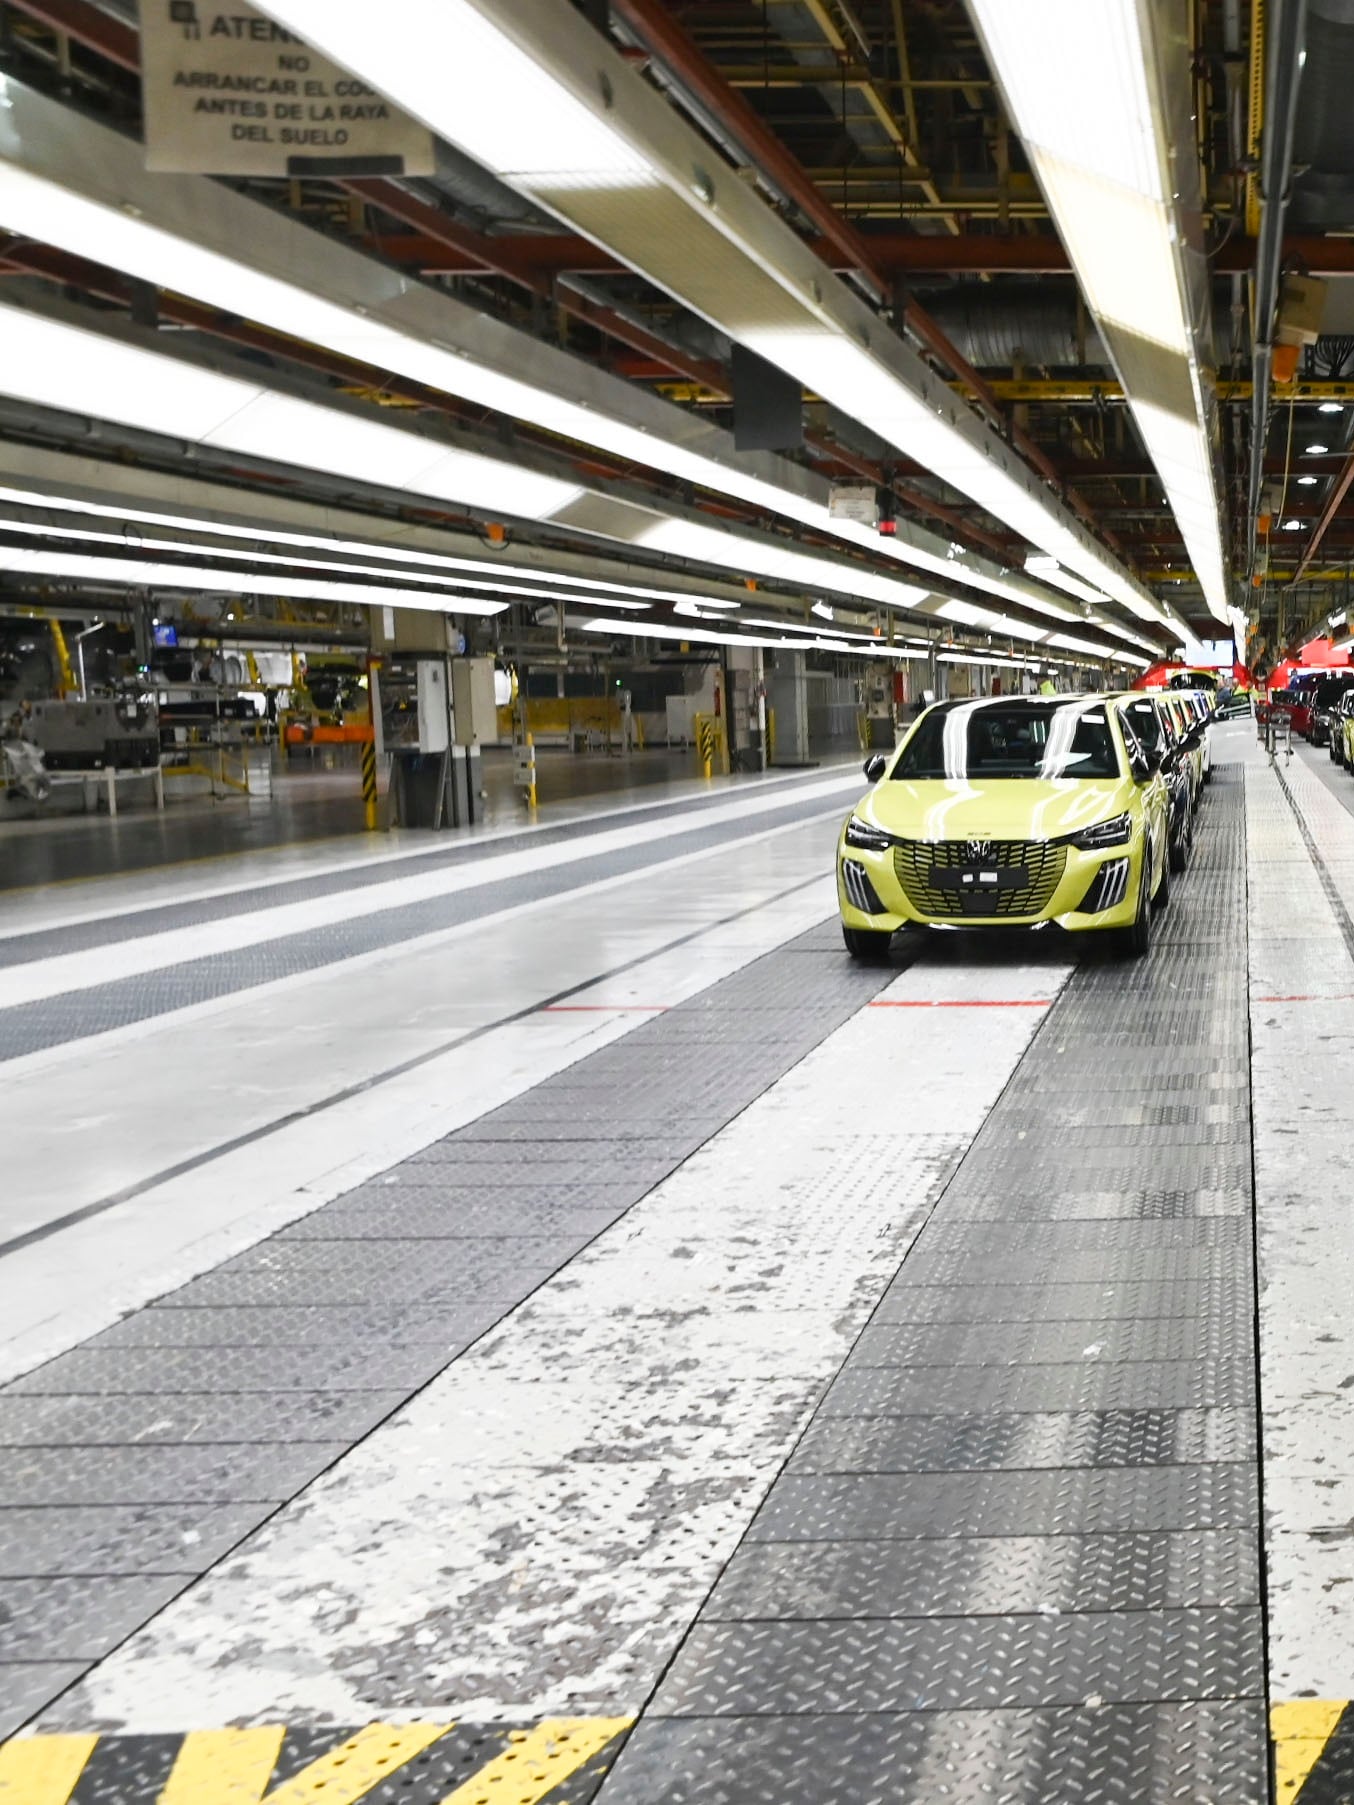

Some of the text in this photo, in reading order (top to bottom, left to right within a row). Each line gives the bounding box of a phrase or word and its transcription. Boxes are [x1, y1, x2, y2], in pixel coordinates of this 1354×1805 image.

[278, 55, 309, 73] NO
[173, 71, 297, 96] ARRANCAR
[305, 81, 328, 97] EL
[194, 98, 389, 121] ANTES DE LA RAYA
[231, 124, 348, 145] DEL SUELO
